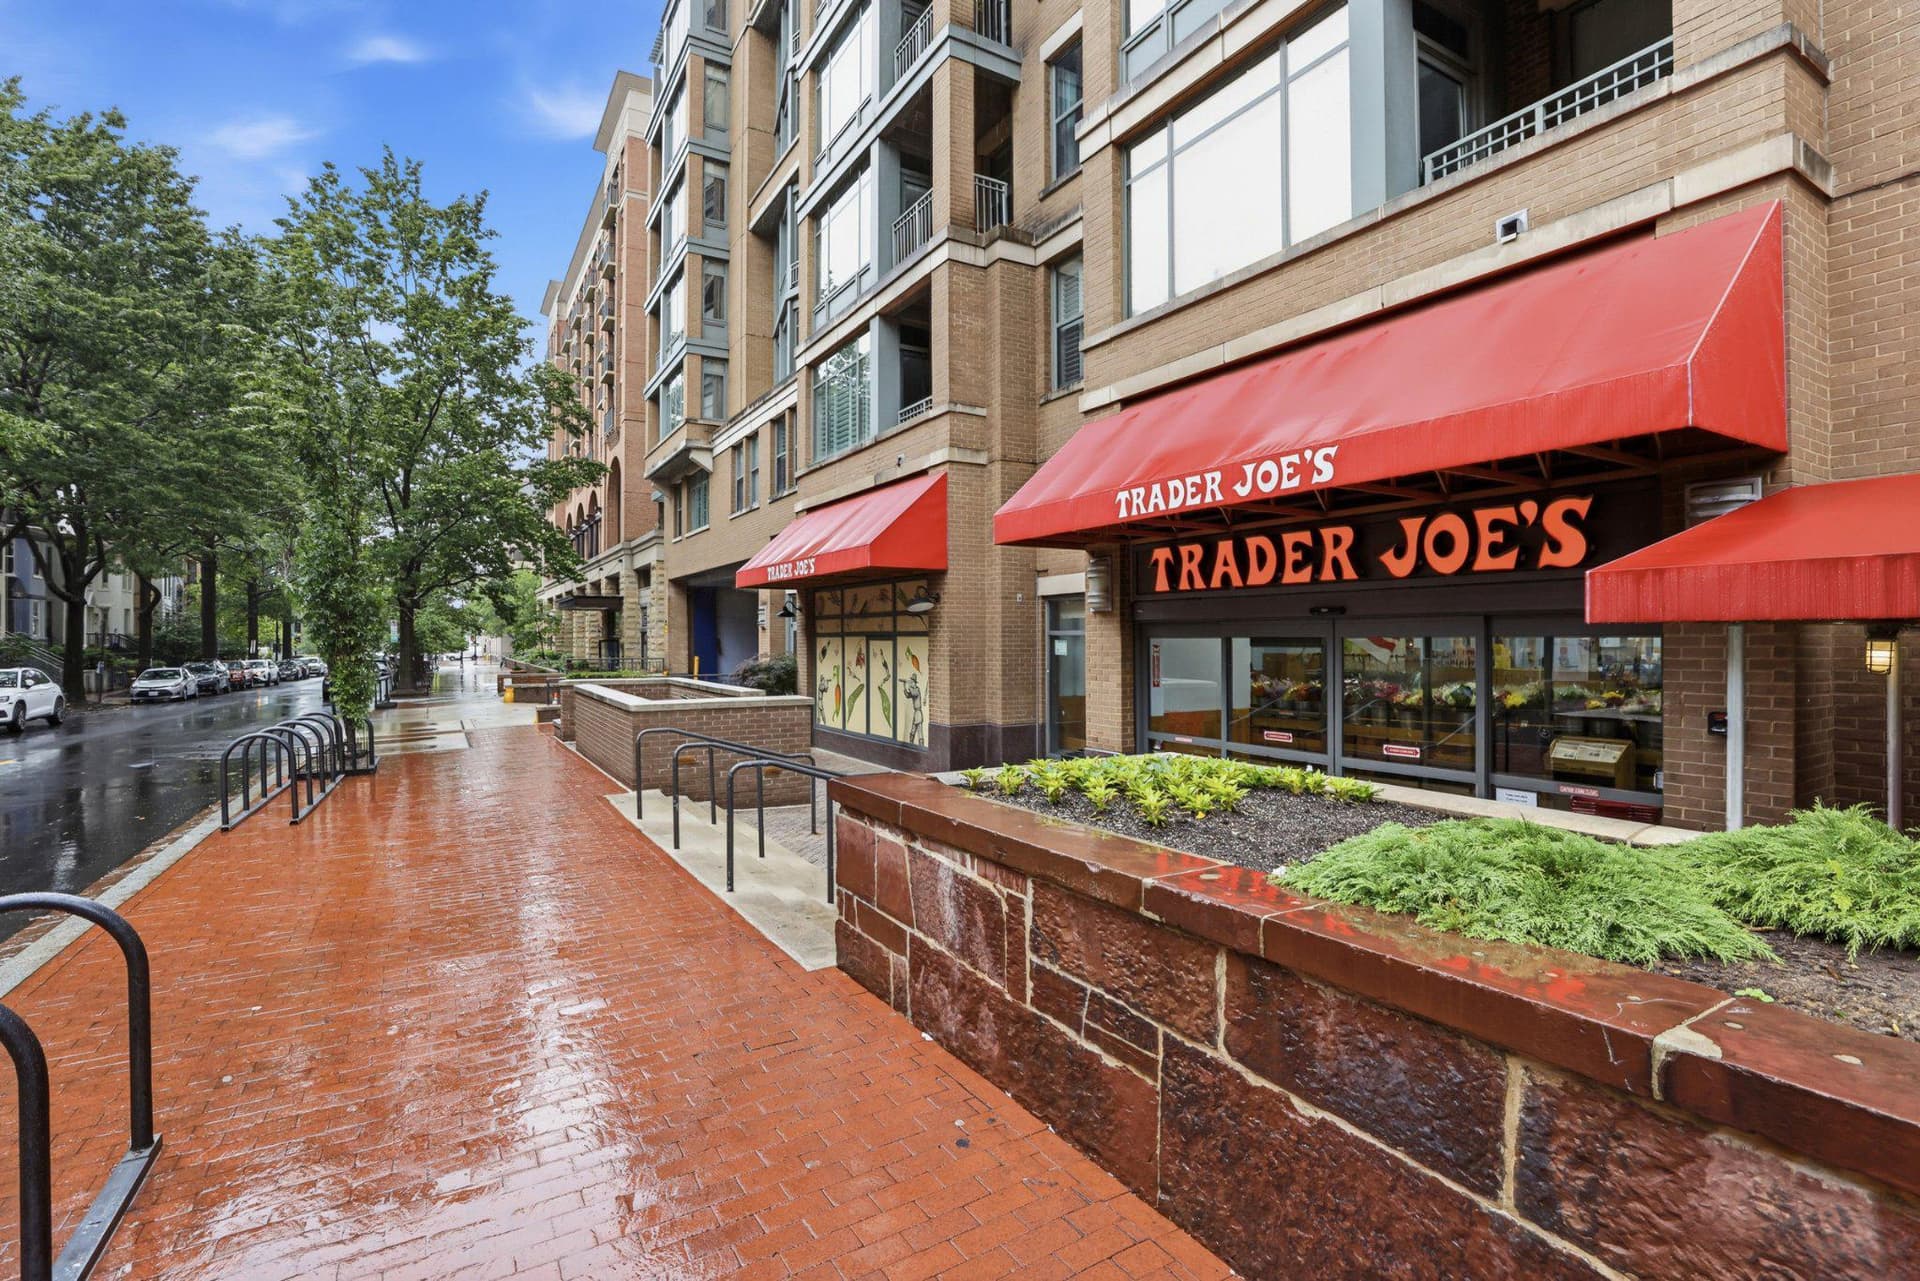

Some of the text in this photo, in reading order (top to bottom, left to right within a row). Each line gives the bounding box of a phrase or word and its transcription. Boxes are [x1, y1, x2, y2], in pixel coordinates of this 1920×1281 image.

[1115, 445, 1338, 518] TRADER JOE'S
[767, 557, 816, 581] TRADER JOE'S
[1150, 494, 1593, 592] TRADER JOE'S
